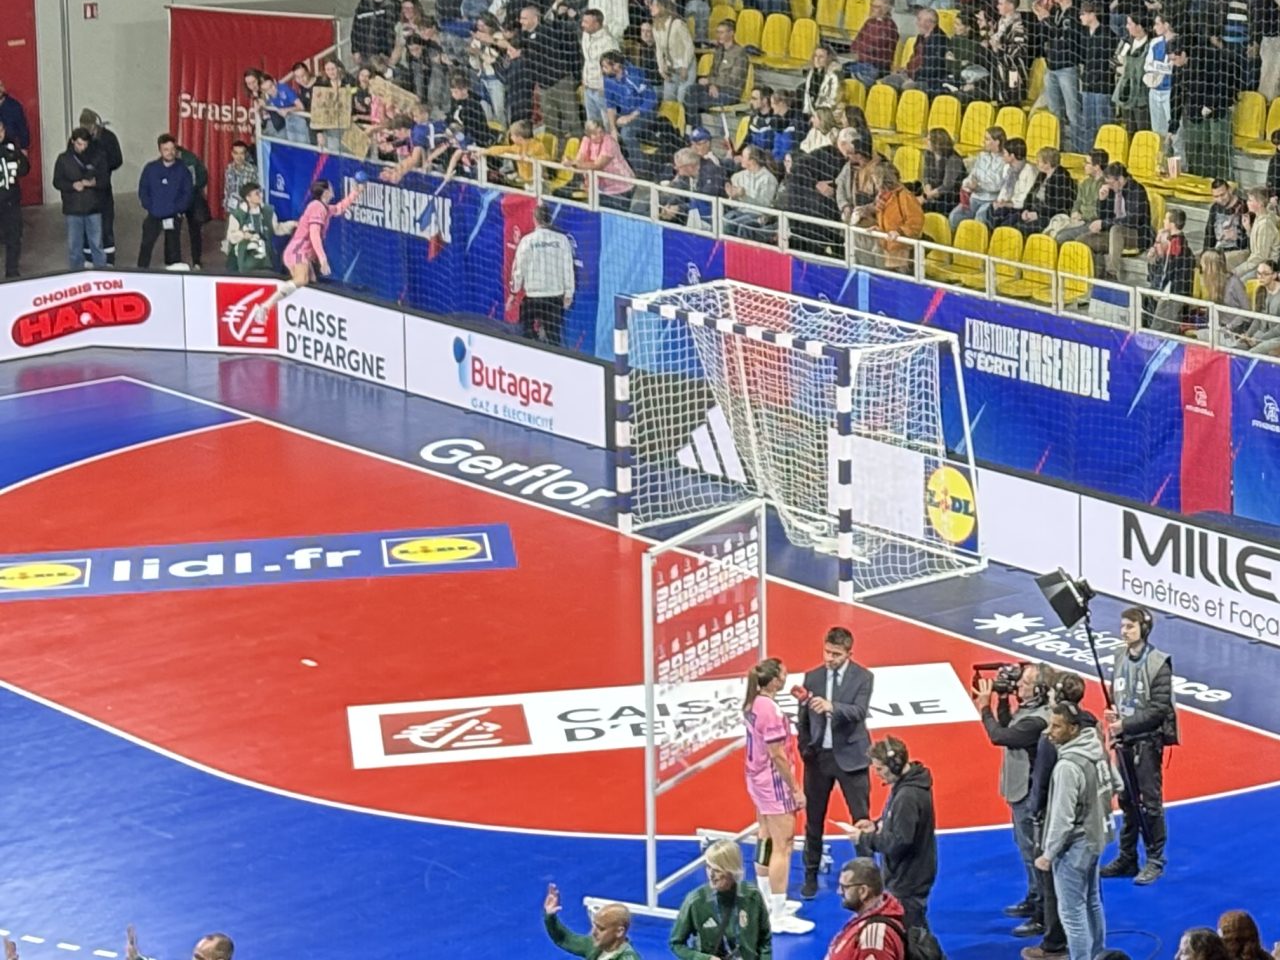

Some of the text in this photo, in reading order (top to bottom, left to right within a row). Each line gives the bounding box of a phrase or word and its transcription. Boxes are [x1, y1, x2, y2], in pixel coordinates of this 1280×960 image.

[33, 279, 124, 307] CHOISIS TON
[19, 295, 146, 345] HAND
[284, 303, 348, 341] CAISSE
[964, 317, 1020, 359] L'HISTOIRE
[286, 331, 387, 380] D'EPARGNE
[964, 349, 1020, 379] S'ÉCRIT
[1019, 329, 1111, 401] ENSEMBLE
[471, 355, 554, 407] Butagaz
[471, 397, 490, 413] GAZ
[927, 488, 976, 517] LIDL
[113, 546, 362, 582] lidl.fr
[1121, 568, 1200, 614] Fenêtres
[1204, 598, 1225, 620] et
